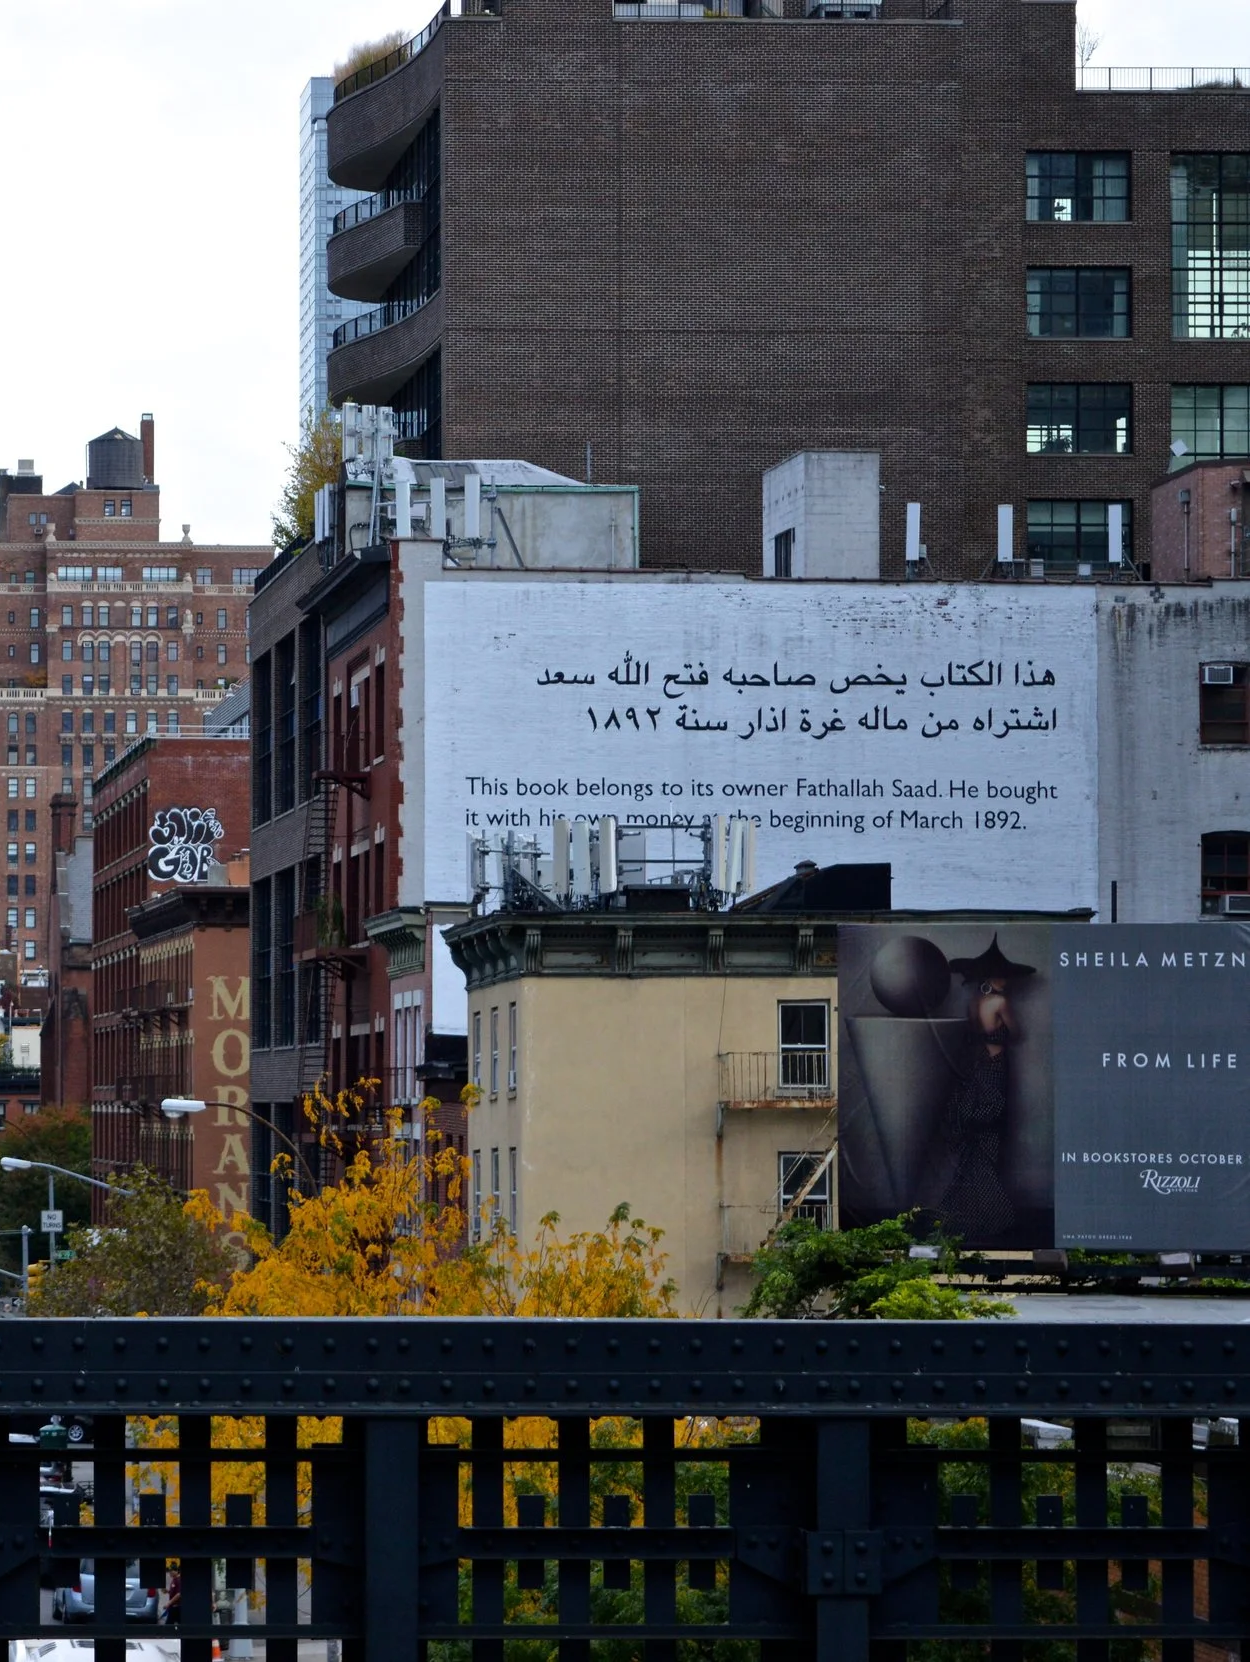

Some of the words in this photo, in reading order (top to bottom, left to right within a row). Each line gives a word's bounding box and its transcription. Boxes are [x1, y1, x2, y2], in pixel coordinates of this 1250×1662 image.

[536, 668, 595, 686] سعد
[663, 661, 709, 699] فتح
[722, 661, 816, 695] صاحبه
[829, 663, 908, 695] يخص
[920, 659, 1002, 697] الكتاب
[1014, 660, 1056, 687] هذا
[675, 704, 728, 731] سنة
[737, 707, 787, 740] اذار
[799, 708, 846, 740] غرة
[857, 705, 908, 730] ماله
[921, 711, 960, 739] من
[972, 706, 1057, 739] اشتراه
[465, 777, 508, 796] This
[516, 777, 569, 796] book
[576, 777, 654, 801] belongs
[662, 782, 683, 797] to
[691, 779, 714, 797] its
[722, 784, 788, 797] owner
[796, 777, 884, 798] Fathallah
[892, 778, 943, 798] Saad.
[949, 779, 979, 799] He
[987, 779, 1059, 805] bought
[465, 808, 478, 827] it
[486, 808, 531, 827] with
[539, 808, 566, 827] his
[626, 812, 694, 833] money
[769, 809, 866, 834] beginning
[872, 809, 895, 829] of
[900, 810, 963, 829] March
[975, 810, 1027, 830] 1892.
[1059, 952, 1149, 967] SHEILA
[1161, 952, 1246, 967] METZN
[1102, 1053, 1171, 1068] FROM
[1187, 1053, 1237, 1069] LIFE
[1061, 1152, 1076, 1162] IN
[1083, 1152, 1173, 1164] BOOKSTORES
[1179, 1153, 1243, 1165] OCTOBER
